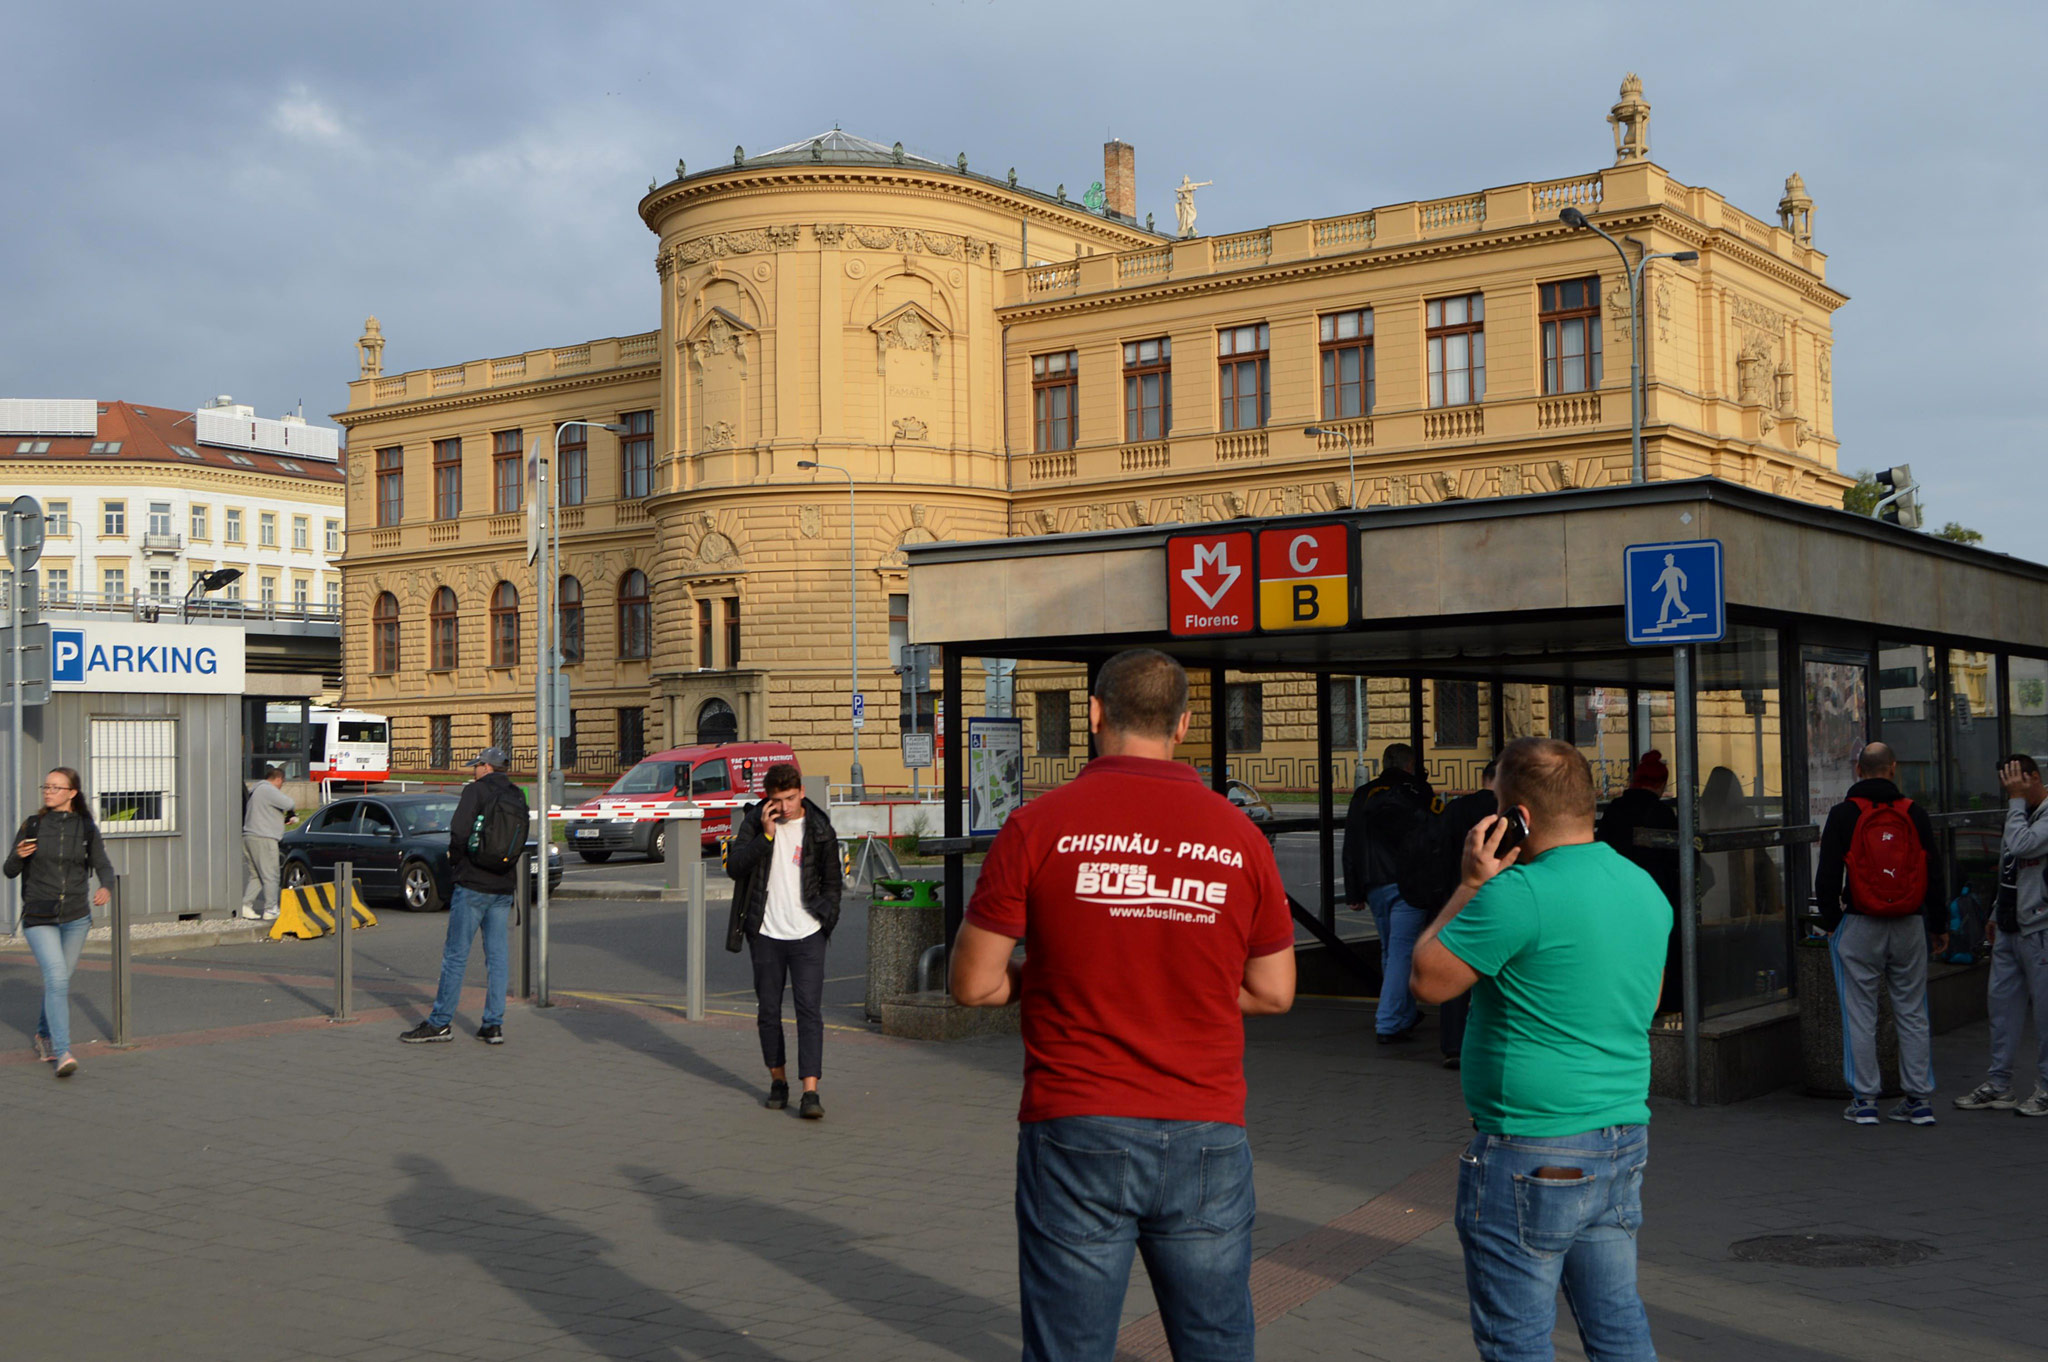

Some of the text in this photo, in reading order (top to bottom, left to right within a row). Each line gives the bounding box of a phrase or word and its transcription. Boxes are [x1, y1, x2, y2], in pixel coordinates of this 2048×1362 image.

[1288, 534, 1319, 574] C
[1292, 584, 1320, 622] B
[1185, 614, 1239, 628] Florenc
[56, 641, 217, 674] PARKING
[1177, 842, 1244, 868] PRAGA
[1078, 862, 1148, 875] EXPRESS
[1109, 905, 1216, 924] www.busline.md
